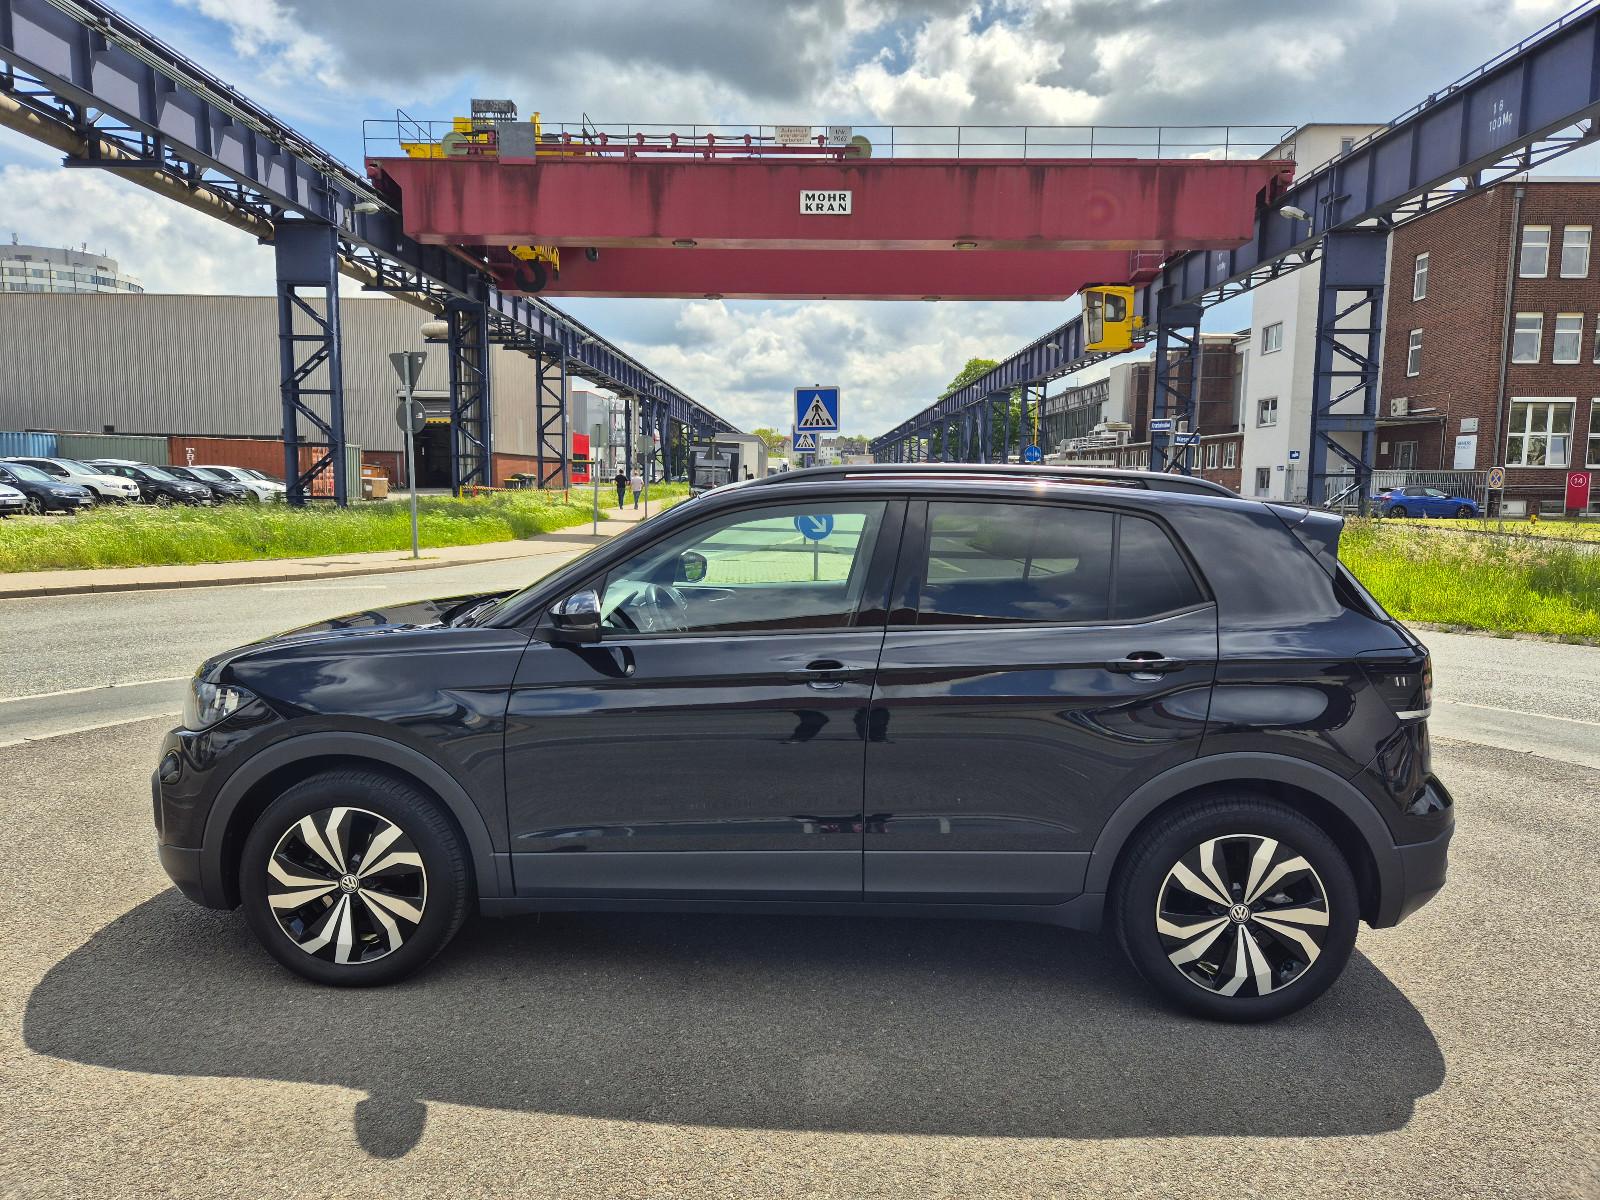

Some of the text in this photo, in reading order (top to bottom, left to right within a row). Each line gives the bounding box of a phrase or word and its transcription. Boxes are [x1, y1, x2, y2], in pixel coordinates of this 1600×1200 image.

[805, 193, 847, 202] MOHR
[805, 202, 847, 212] KRAN
[1231, 905, 1249, 922] VW
